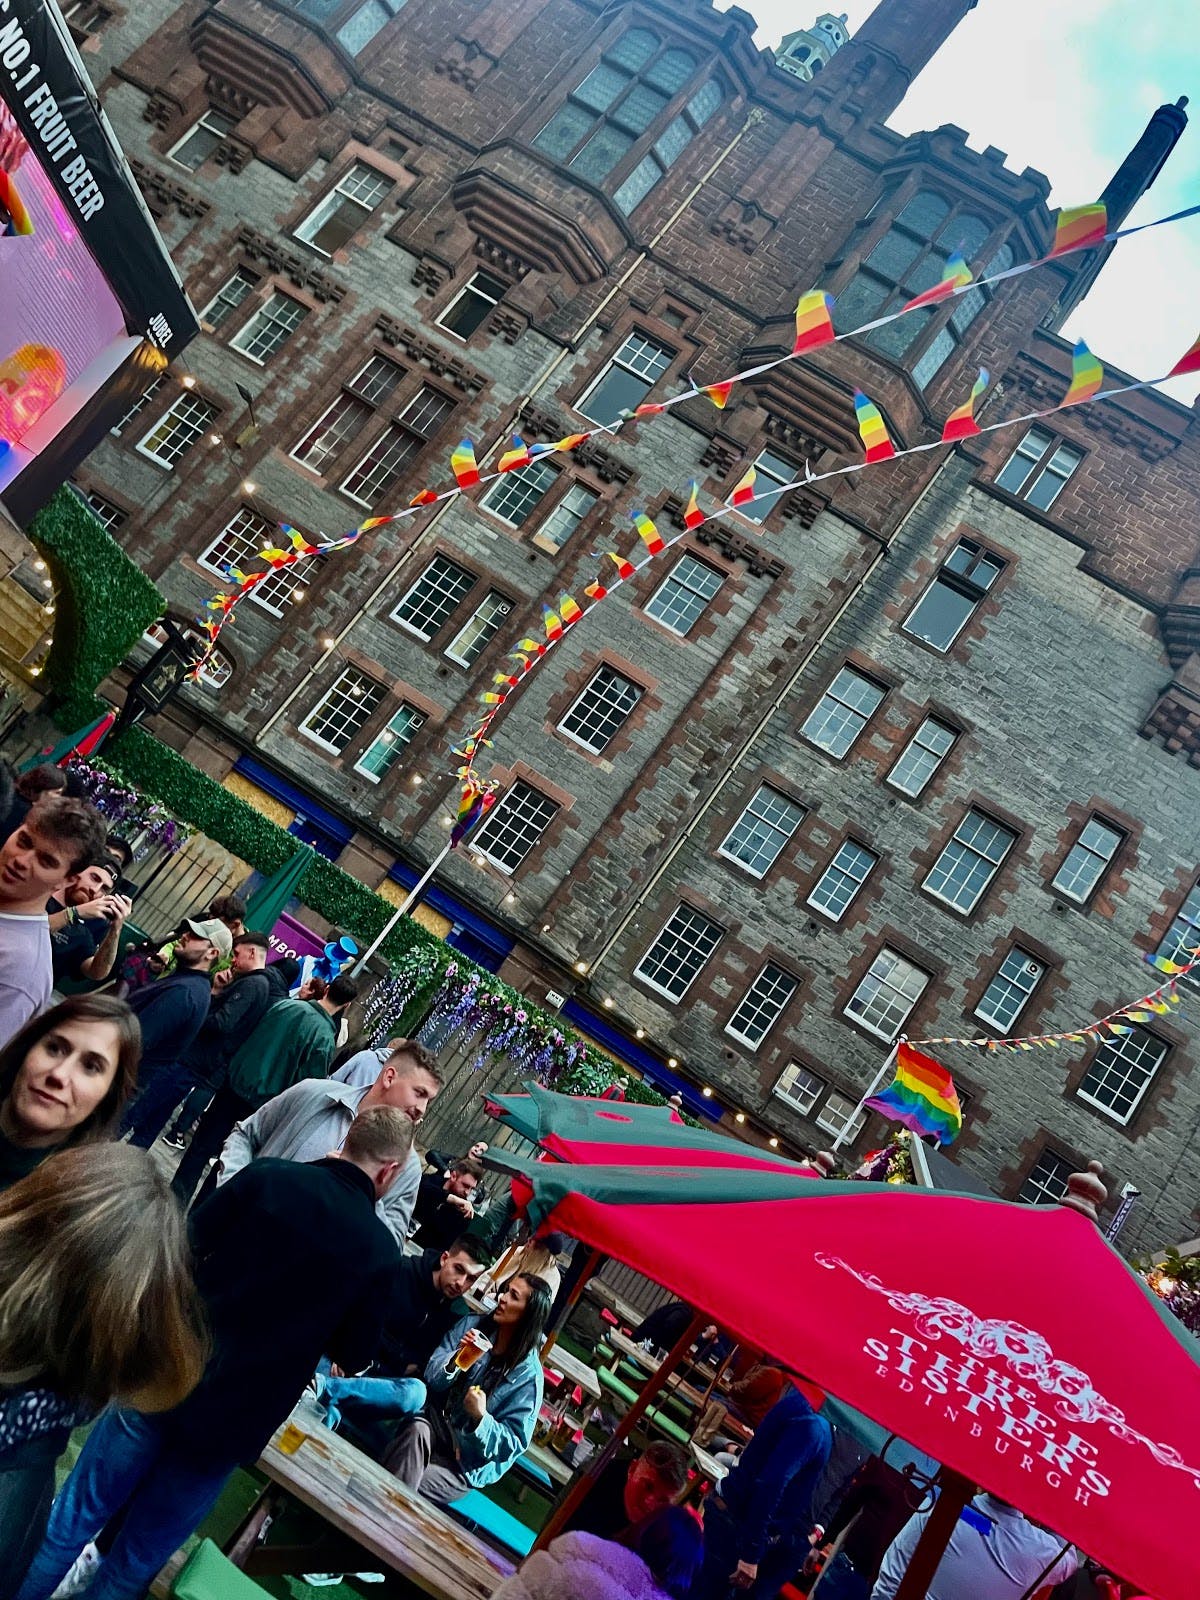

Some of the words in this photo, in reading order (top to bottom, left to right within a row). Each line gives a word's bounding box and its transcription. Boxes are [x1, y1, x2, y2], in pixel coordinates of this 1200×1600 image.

[0, 17, 40, 91] NO.1
[23, 82, 77, 162] FRUIT
[60, 154, 105, 222] BEER
[149, 312, 174, 348] JUBEL
[268, 934, 302, 961] MBO
[862, 1337, 1112, 1497] SISTERS
[875, 1364, 1092, 1507] EDINBURGH
[889, 1327, 1099, 1467] THREE
[959, 1352, 1037, 1406] THE
